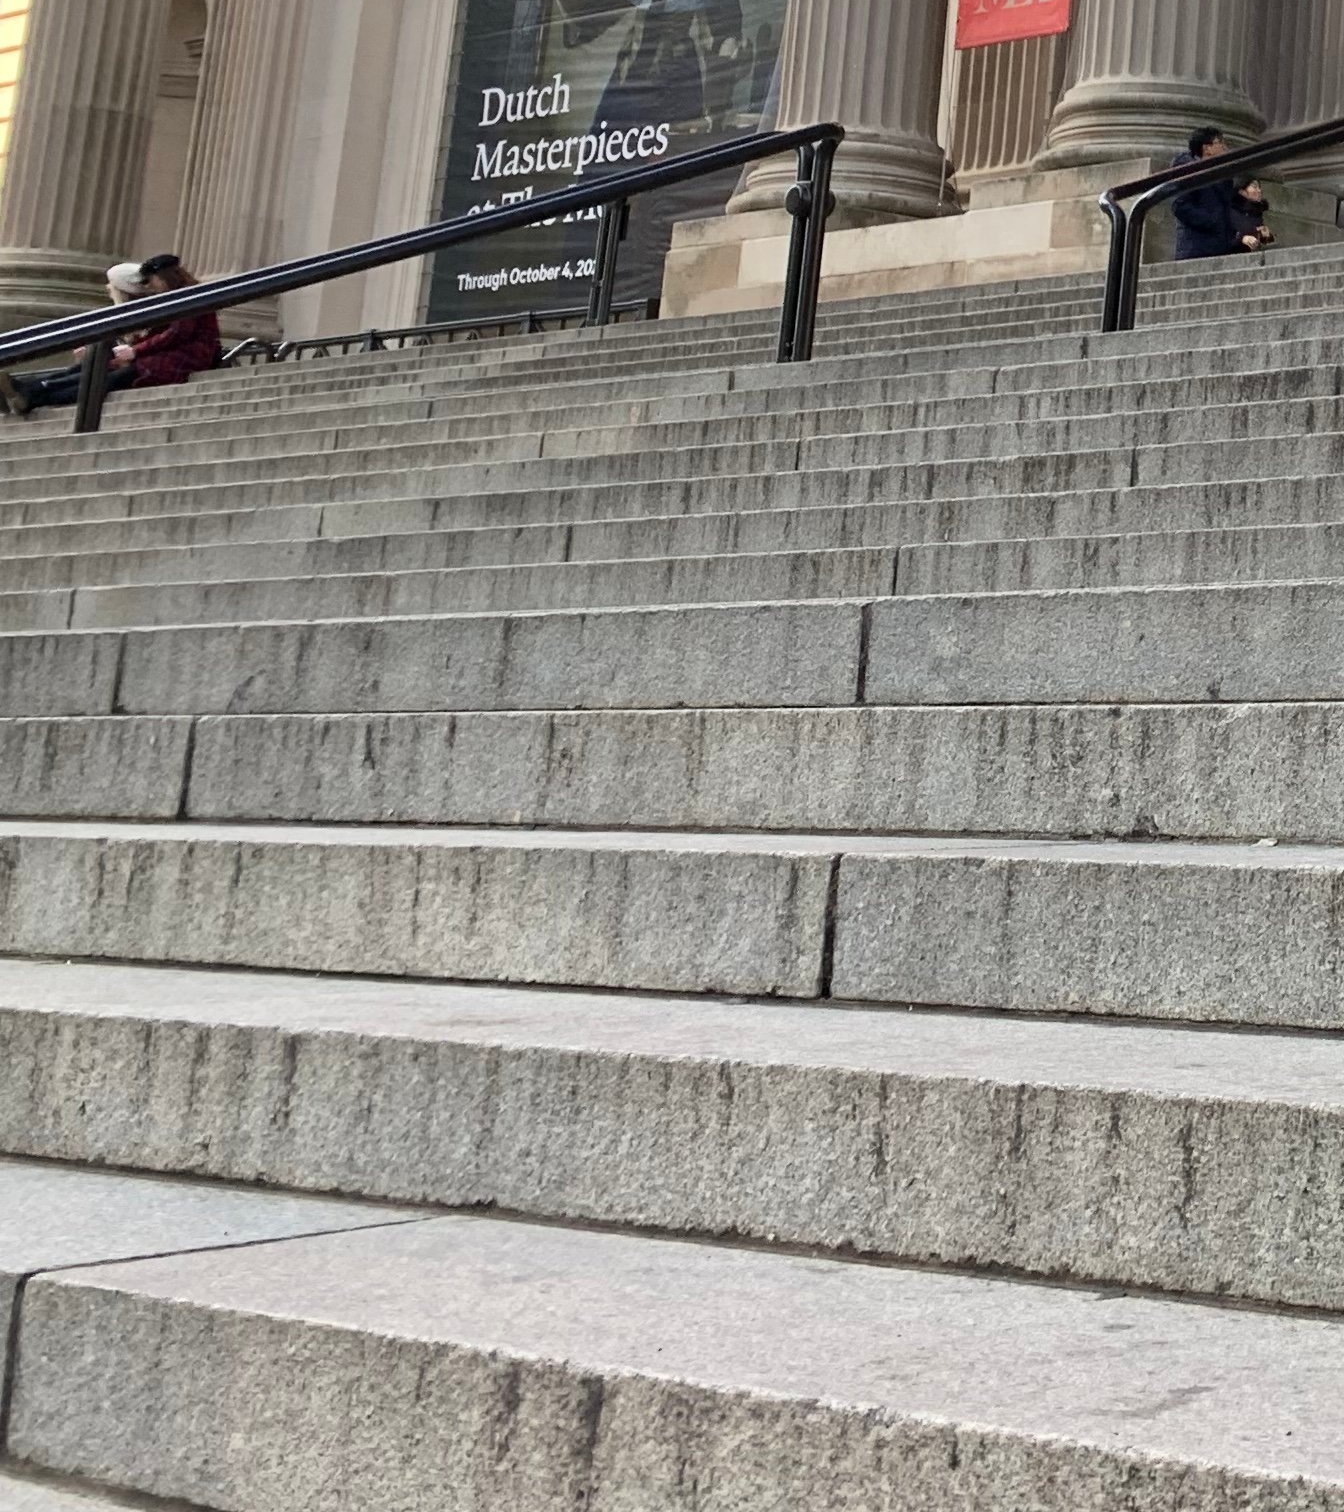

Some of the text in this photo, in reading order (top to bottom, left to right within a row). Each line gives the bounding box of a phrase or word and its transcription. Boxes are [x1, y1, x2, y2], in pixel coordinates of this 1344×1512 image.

[478, 73, 570, 127] Dutch
[470, 120, 670, 181] Masterpieces
[457, 268, 508, 292] Through
[509, 263, 561, 285] October
[561, 261, 574, 280] 4,
